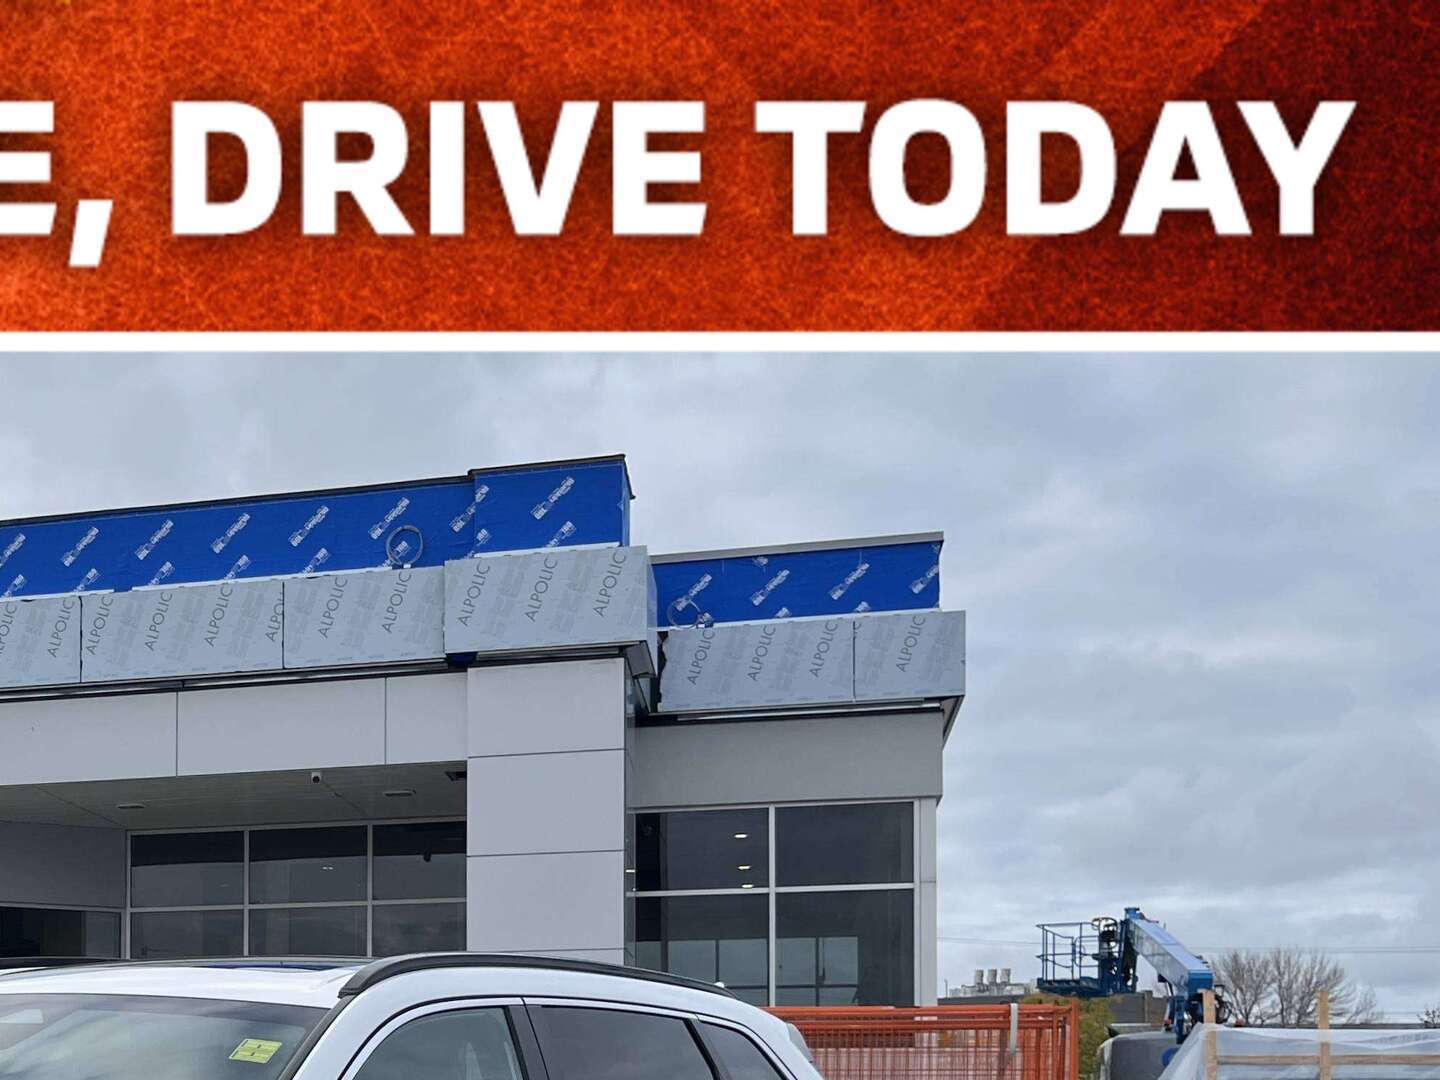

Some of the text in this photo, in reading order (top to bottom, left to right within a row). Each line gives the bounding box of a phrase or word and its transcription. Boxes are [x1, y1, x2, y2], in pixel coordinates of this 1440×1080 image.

[318, 577, 347, 638] ALPOLIC
[382, 571, 411, 633] ALPOLIC
[458, 563, 490, 627] ALPOLIC
[525, 558, 558, 622] ALPOLIC
[593, 550, 626, 617] ALPOLIC
[47, 600, 75, 658] ALPOLIC
[86, 597, 113, 655] ALPOLIC
[145, 591, 172, 651] ALPOLIC
[203, 586, 233, 647] ALPOLIC
[895, 615, 925, 673] ALPOLIC
[687, 630, 715, 686] ALPOLIC
[747, 625, 776, 681] ALPOLIC
[809, 621, 838, 678] ALPOLIC
